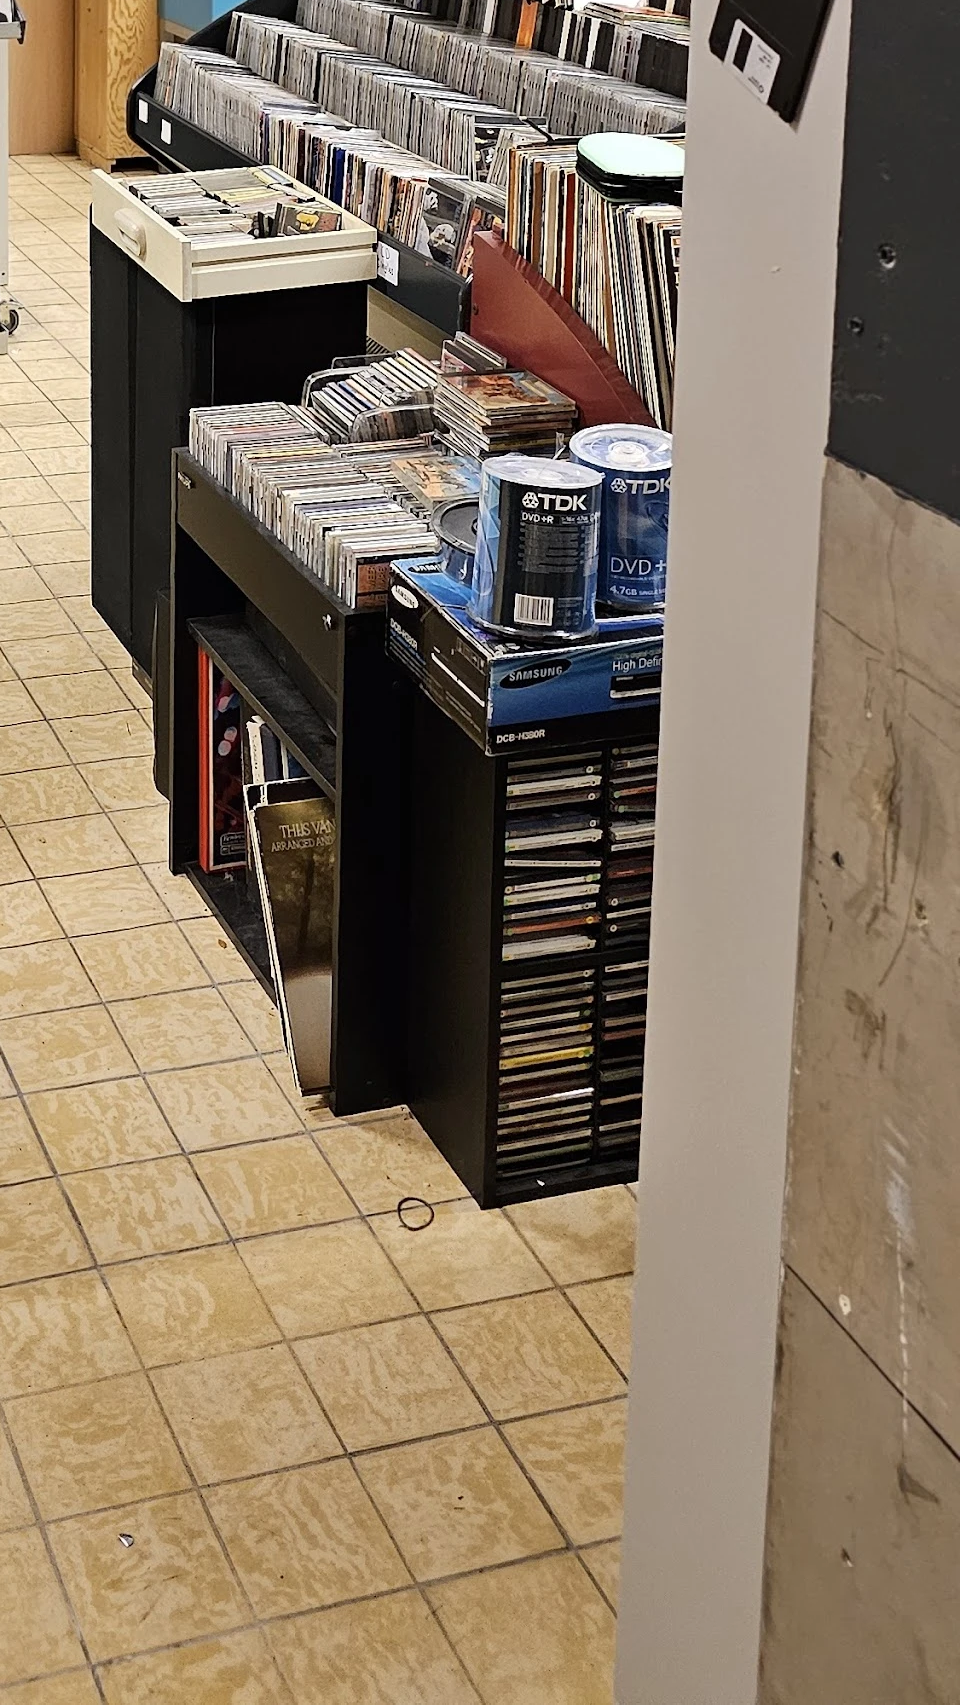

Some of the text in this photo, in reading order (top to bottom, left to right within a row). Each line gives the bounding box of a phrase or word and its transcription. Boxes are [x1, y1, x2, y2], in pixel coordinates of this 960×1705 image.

[625, 479, 670, 495] TDK
[537, 493, 588, 512] TDK
[509, 665, 563, 682] SAMSUNG
[612, 659, 636, 673] High
[310, 818, 337, 835] VAN
[271, 838, 315, 852] ARRANGED
